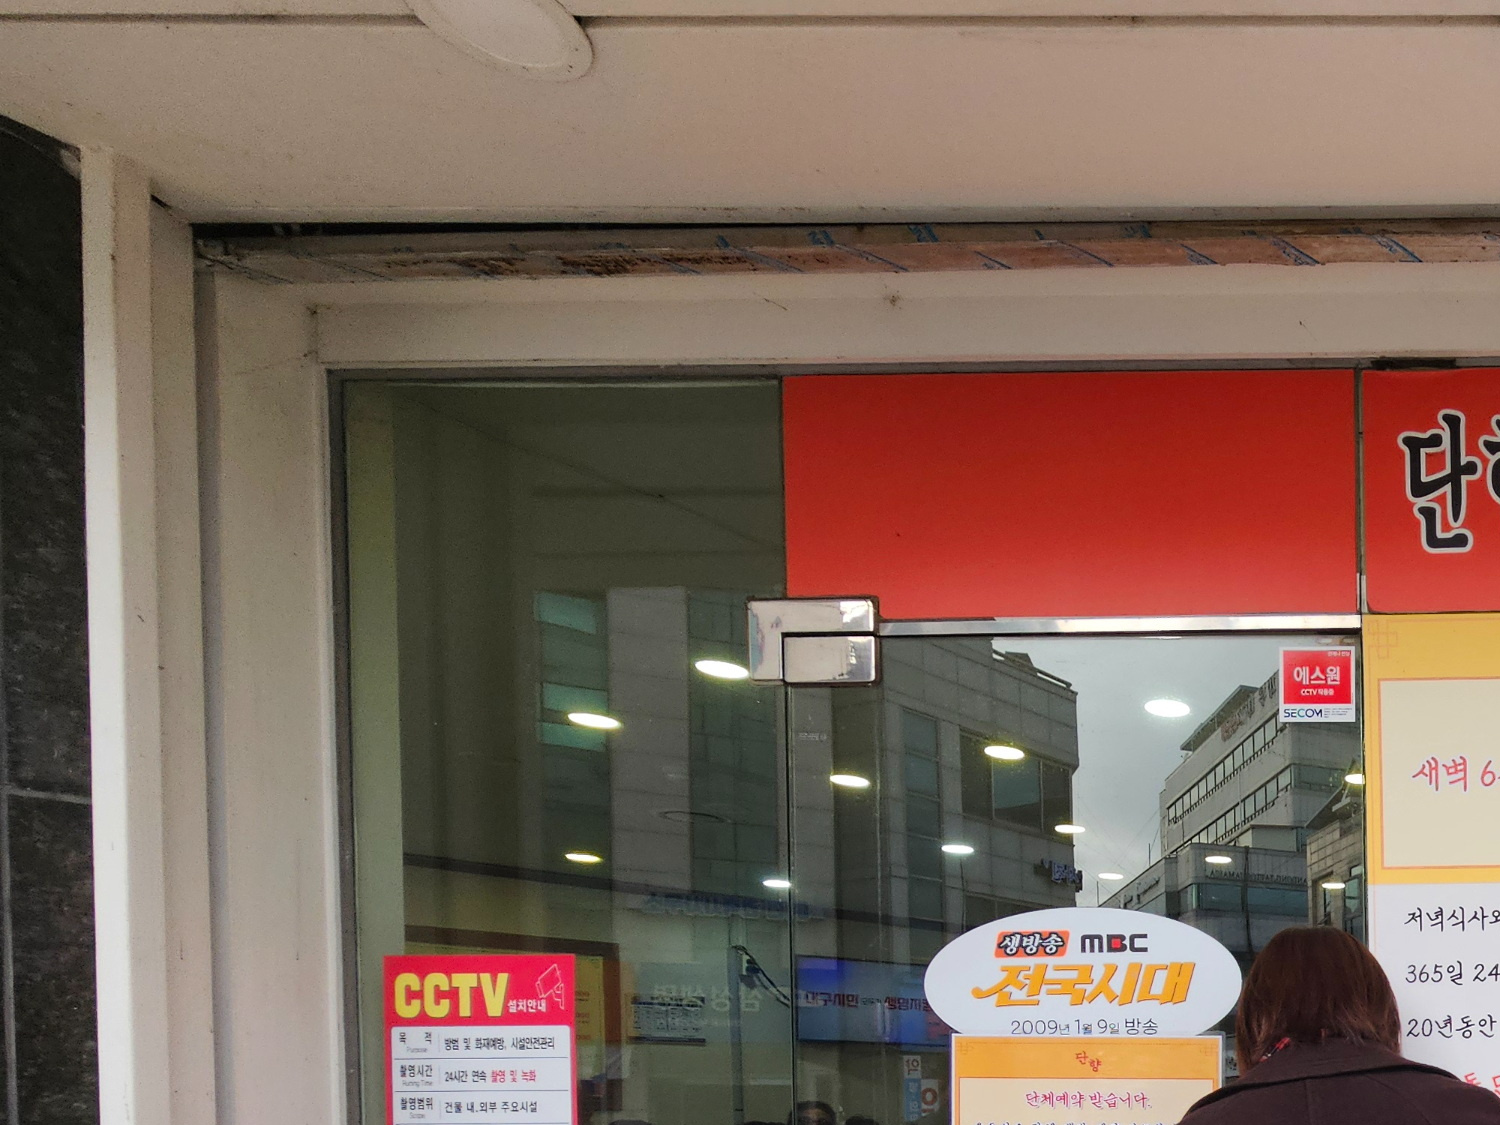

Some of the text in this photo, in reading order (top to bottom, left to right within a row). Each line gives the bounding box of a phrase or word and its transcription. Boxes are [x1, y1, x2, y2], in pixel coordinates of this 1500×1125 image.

[1293, 666, 1341, 685] 에스원
[1300, 688, 1317, 696] CCTV
[1283, 708, 1323, 719] SECOM
[1412, 756, 1468, 792] 새벽
[999, 931, 1066, 956] 생방송
[1080, 933, 1148, 953] MBC
[1405, 961, 1464, 986] 365일
[971, 962, 1196, 1007] 전국시대
[394, 973, 509, 1018] CCTV
[507, 1000, 547, 1013] 설치안내
[1010, 1017, 1160, 1036] 2009년 1월 9일 방송
[1407, 1014, 1498, 1039] 20년동안
[1075, 1051, 1102, 1073] 단향
[444, 1070, 468, 1084] 24시간
[472, 1070, 487, 1083] 연속
[521, 1069, 537, 1082] 녹화
[444, 1102, 463, 1113] 건물
[501, 1101, 538, 1113] 주요시설
[1025, 1091, 1152, 1110] 단체예약 받습니다.
